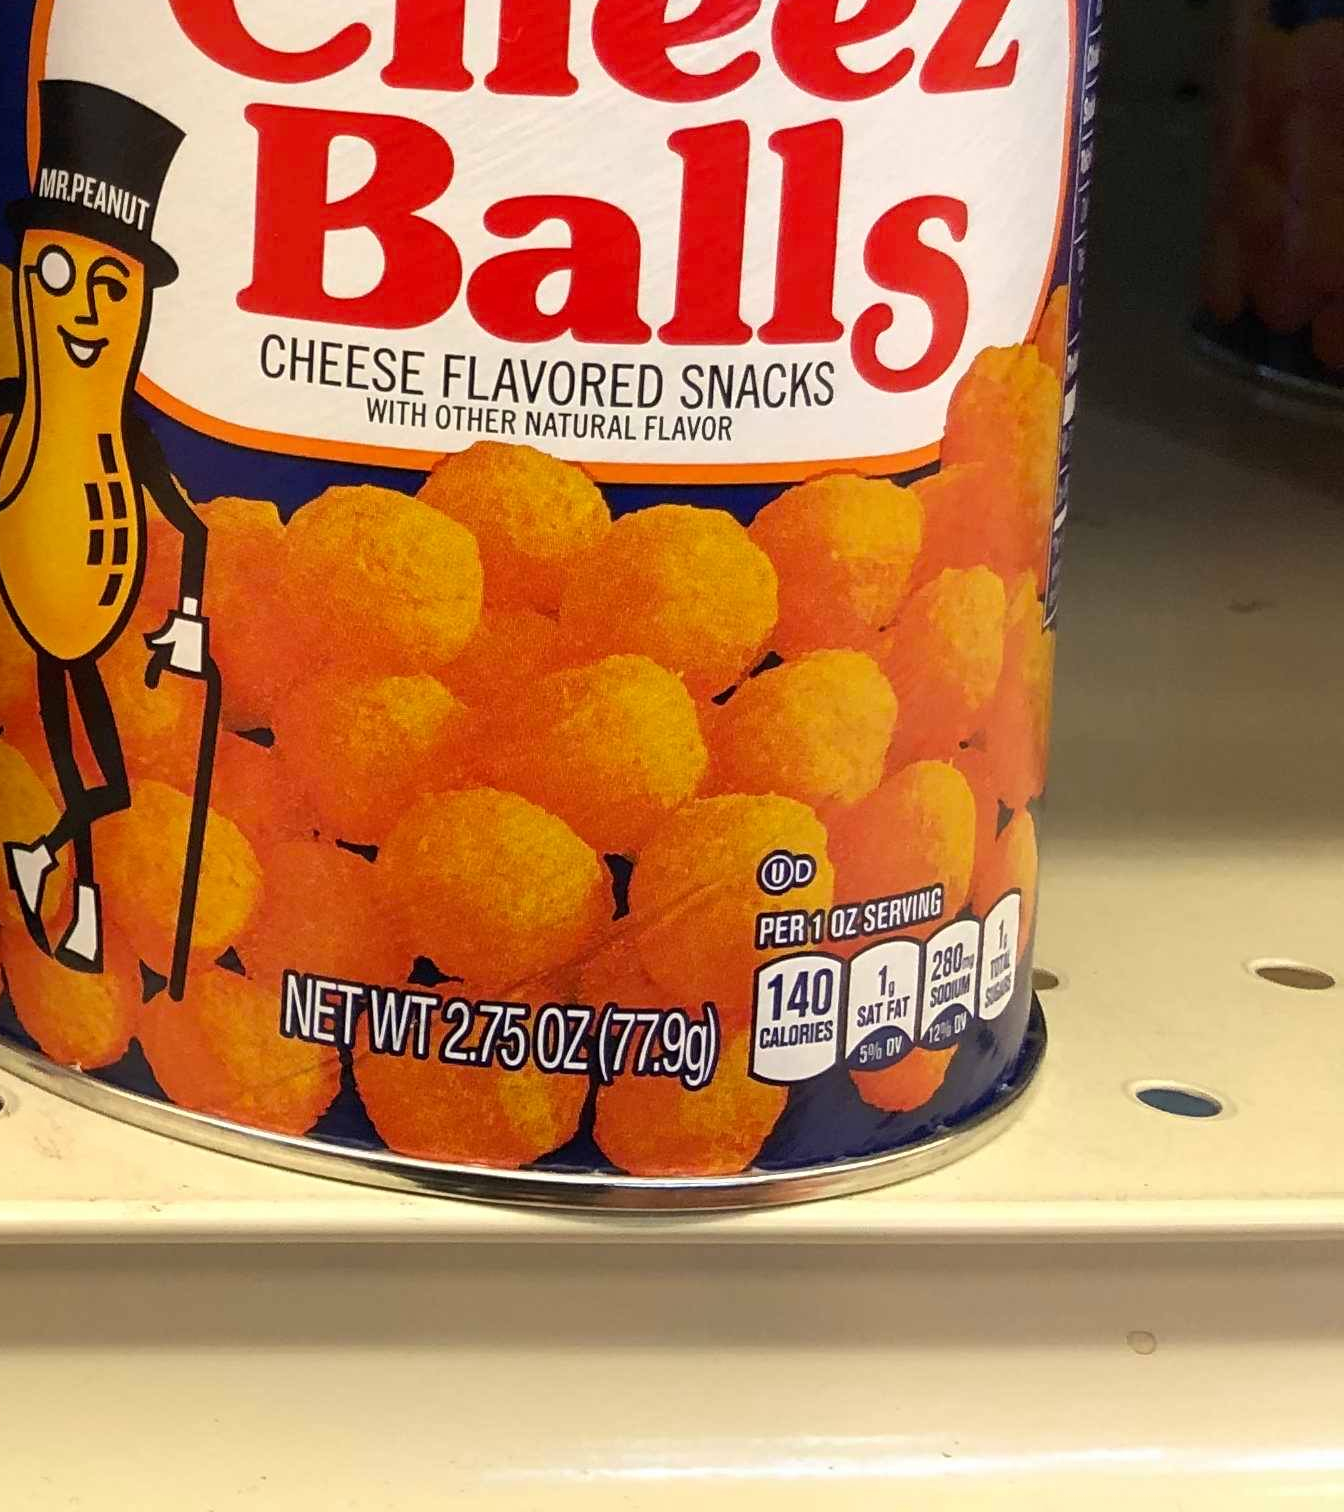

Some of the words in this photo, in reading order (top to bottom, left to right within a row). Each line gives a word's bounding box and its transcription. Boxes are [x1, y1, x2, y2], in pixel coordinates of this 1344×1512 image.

[237, 102, 968, 393] Balls
[260, 334, 425, 398] CHEESE
[441, 353, 662, 408] FLAVORED
[680, 361, 835, 409] SNACKS
[366, 396, 427, 429] WITH
[435, 402, 515, 436] OTHER
[525, 410, 637, 441] NATURAL
[644, 414, 733, 441] FLAVOR
[760, 916, 804, 945] PER
[813, 918, 821, 939] 1
[831, 909, 856, 936] OZ
[864, 888, 941, 932] SERVING
[767, 968, 833, 1021] 140
[857, 1004, 884, 1028] SAT
[887, 996, 910, 1021] FAT
[930, 974, 970, 1008] SODIUM
[286, 974, 363, 1044] NET
[371, 990, 437, 1054] WT
[444, 1001, 525, 1066] 2.75
[539, 1007, 590, 1070] OZ
[599, 1007, 717, 1085] (77.9g)
[759, 1020, 833, 1049] CALORIES
[859, 1043, 882, 1063] 5%
